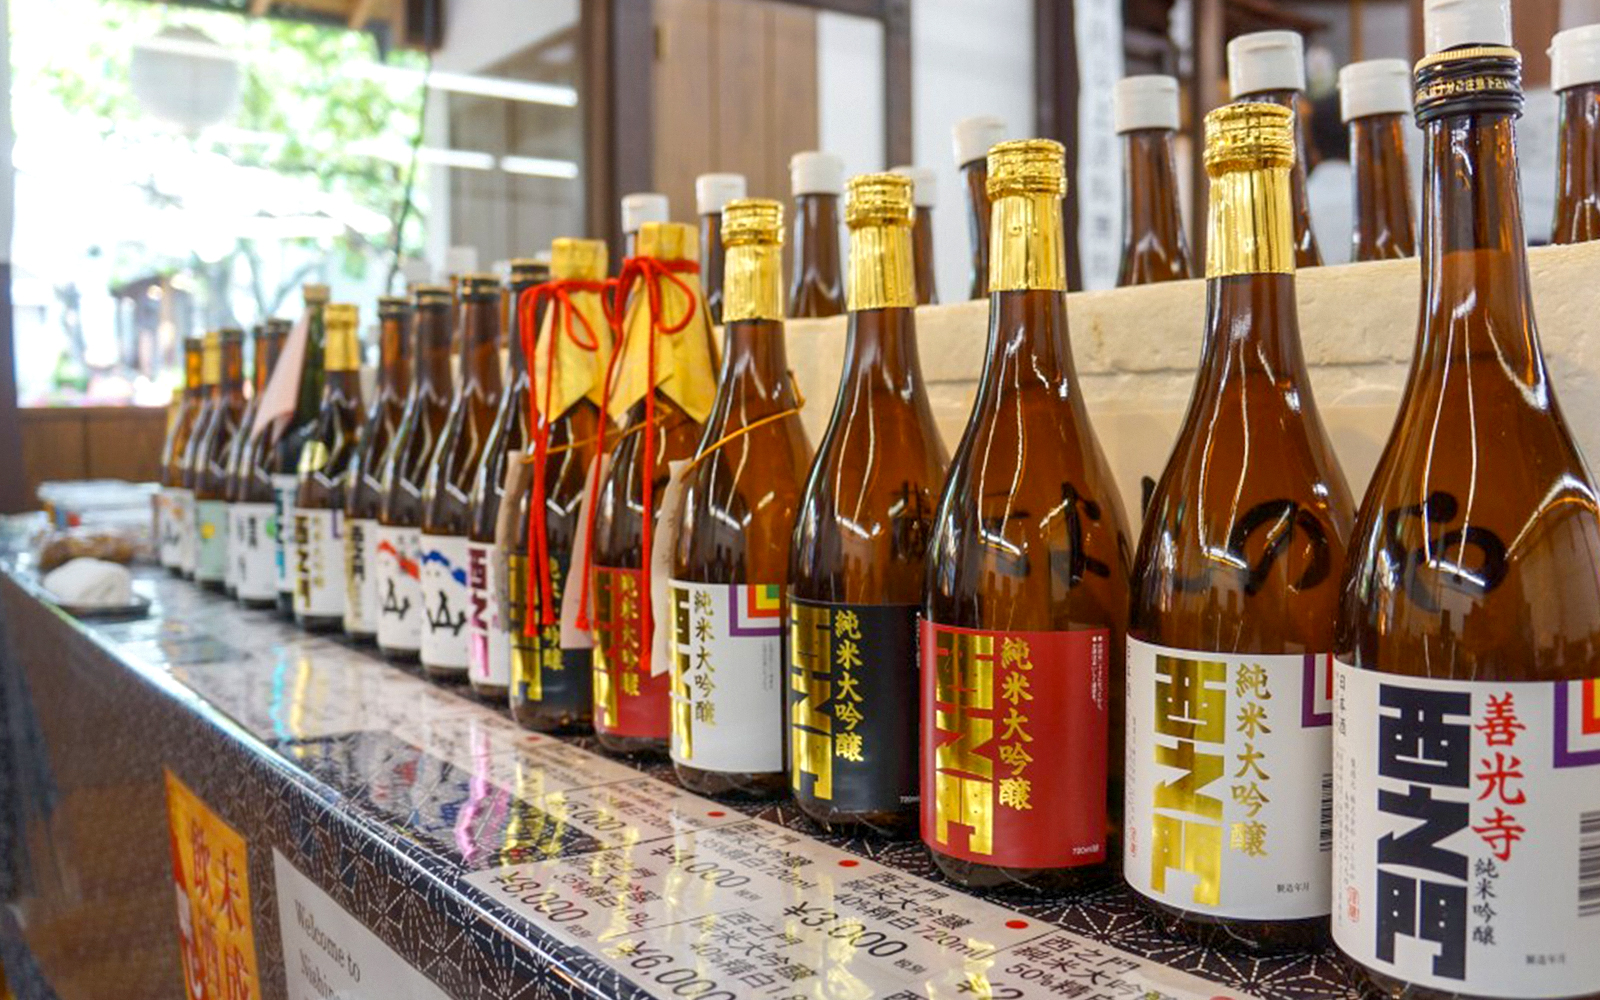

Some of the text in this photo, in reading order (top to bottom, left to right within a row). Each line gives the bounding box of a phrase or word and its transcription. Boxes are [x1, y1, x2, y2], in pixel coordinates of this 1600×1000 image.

[694, 589, 716, 727] 純米大吟醸
[791, 603, 832, 800] 西之門
[834, 609, 864, 762] 純米大吟醸
[998, 637, 1034, 810] 純米大吟醸
[935, 630, 994, 856] 西之門
[1151, 653, 1227, 907] 西之門
[1230, 663, 1272, 857] 純米大吟醸
[1473, 691, 1527, 862] 善光寺
[868, 871, 951, 901] 西之門
[1376, 682, 1472, 981] 西之門
[1471, 857, 1500, 946] 純米吟醸
[294, 899, 361, 983] Welcome to
[782, 901, 908, 957] ¥3,000
[841, 879, 975, 930] 純米大吟醸
[1011, 946, 1160, 1000] 純米大吟
[1039, 935, 1141, 974] 西之門
